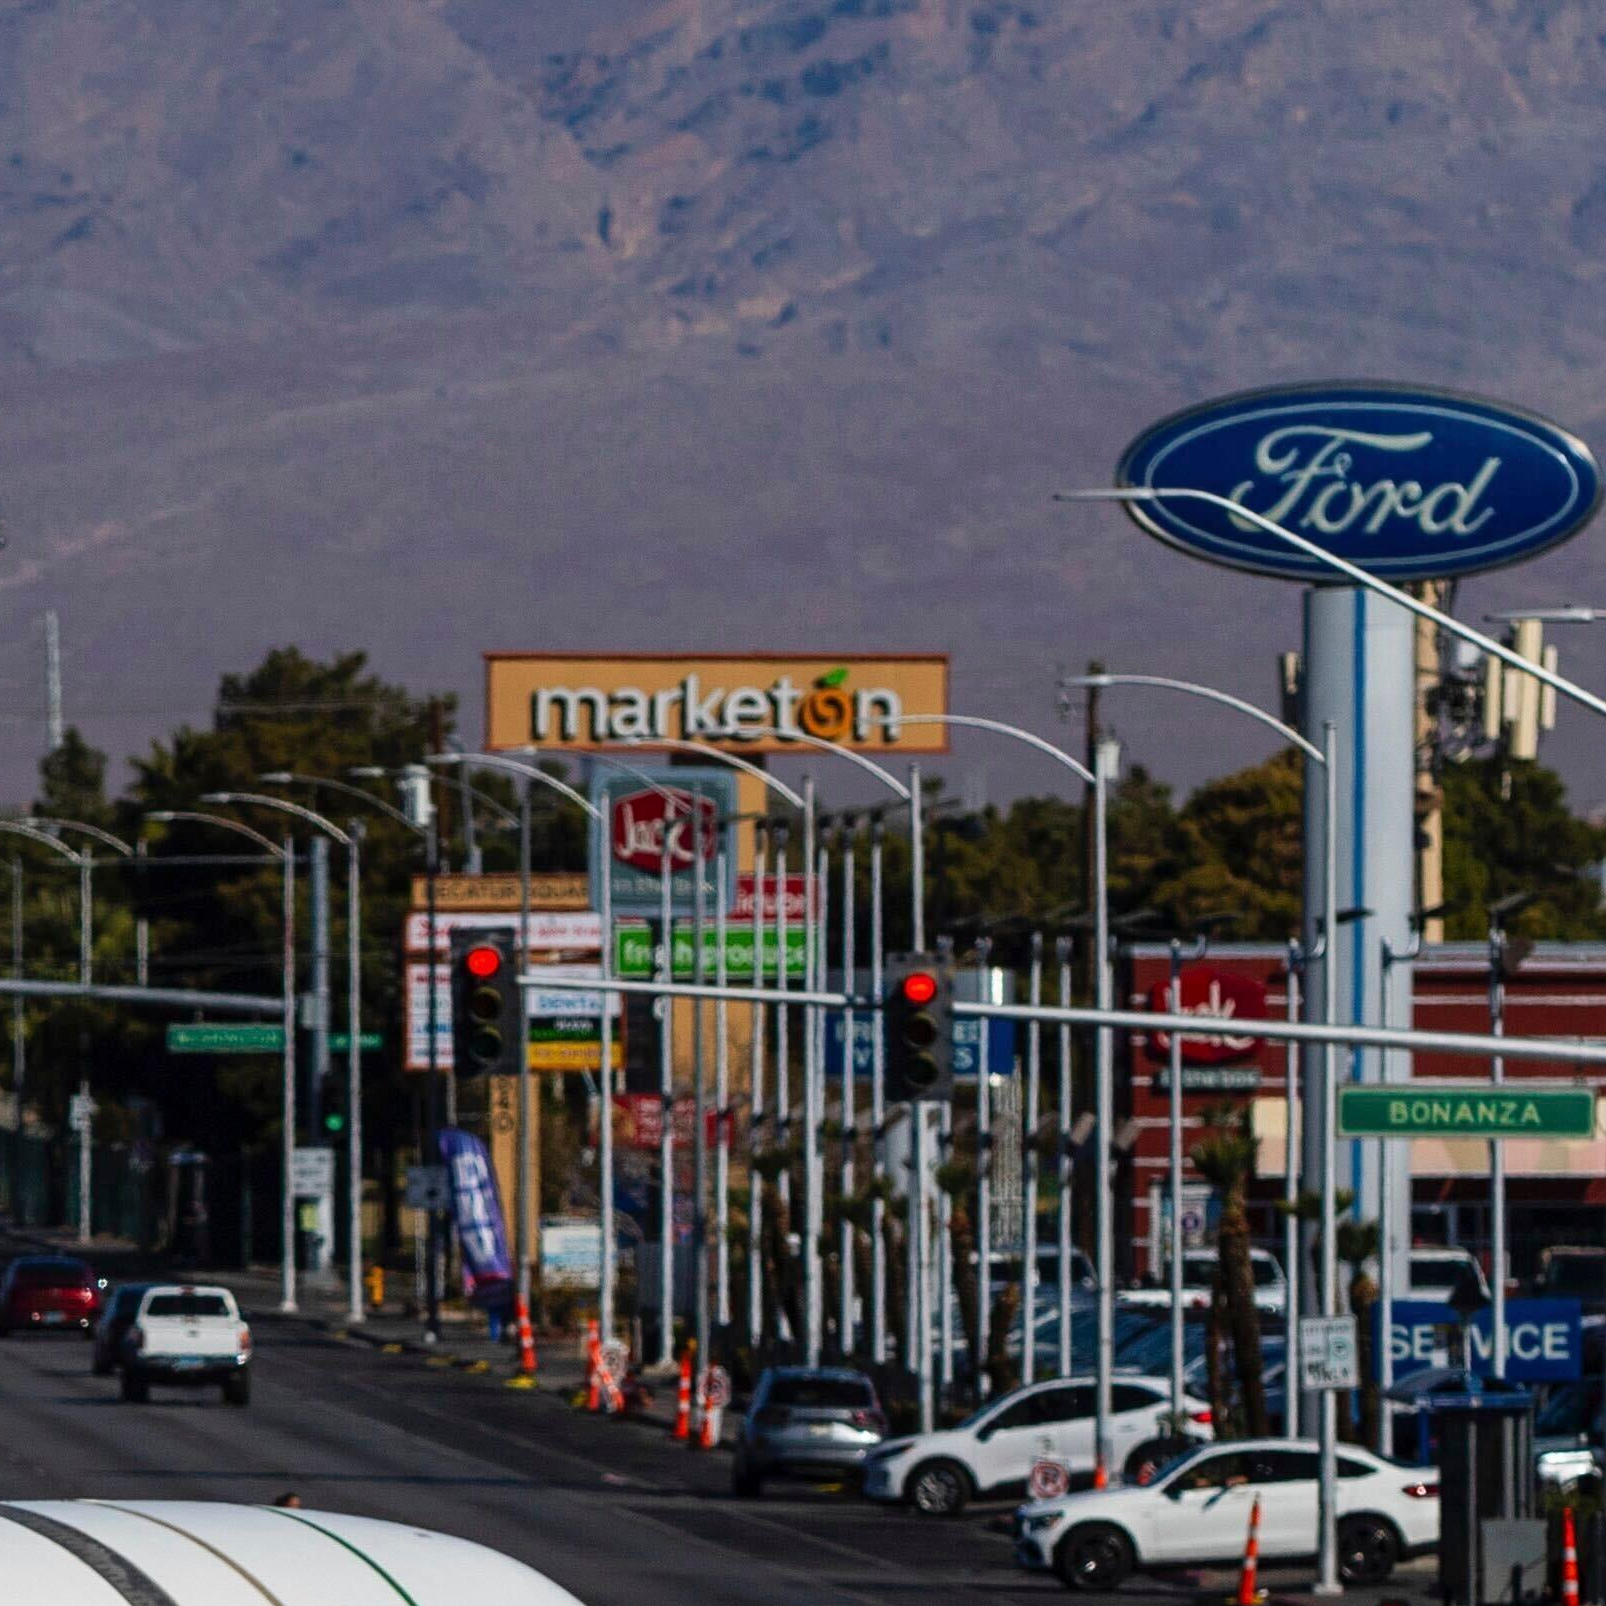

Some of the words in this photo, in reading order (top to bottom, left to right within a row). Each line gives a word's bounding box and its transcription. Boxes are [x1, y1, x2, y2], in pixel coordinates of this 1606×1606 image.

[1228, 424, 1501, 536] Ford
[532, 672, 903, 742] marketon
[1388, 1100, 1541, 1125] BONANZA
[1389, 1322, 1571, 1361] SEVICE
